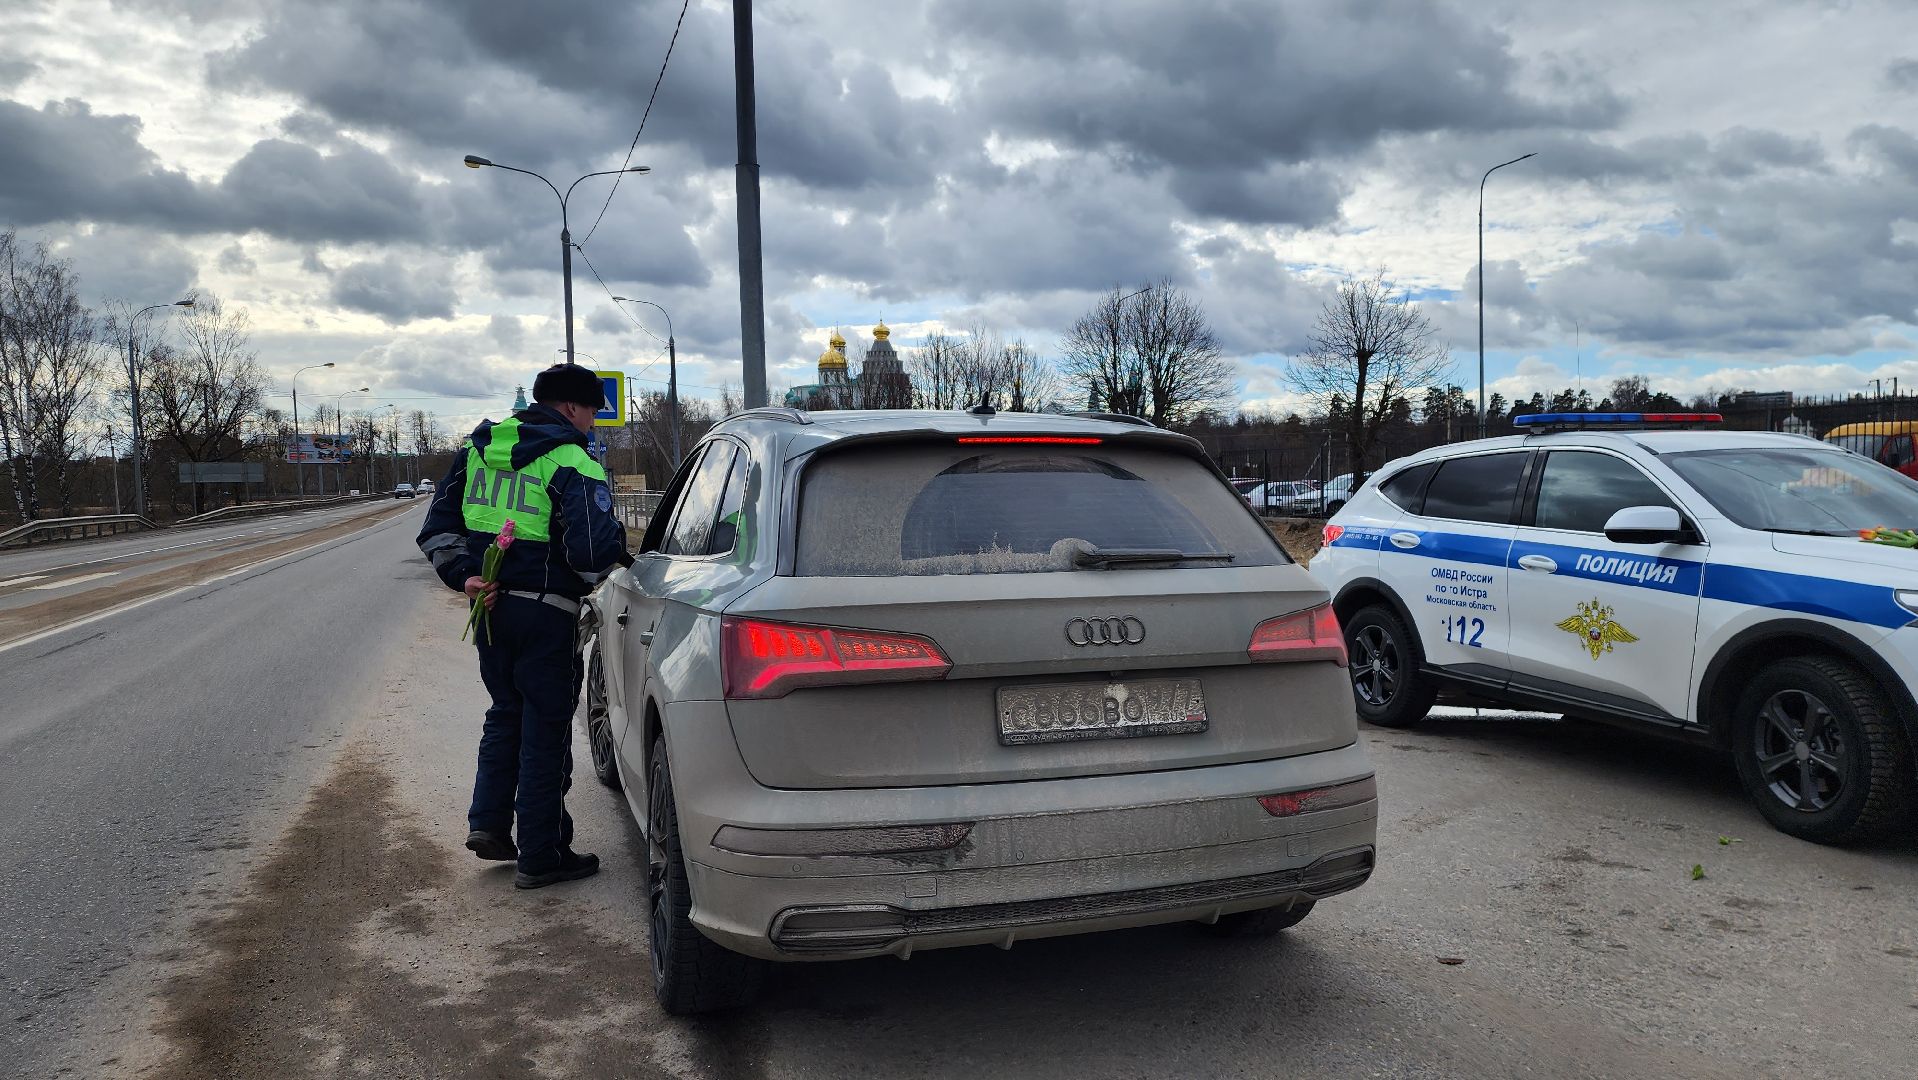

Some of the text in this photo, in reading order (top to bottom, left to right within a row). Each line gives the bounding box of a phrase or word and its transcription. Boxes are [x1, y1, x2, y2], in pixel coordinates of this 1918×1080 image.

[466, 467, 542, 515] ДПС
[1431, 567, 1494, 584] ОМВД России
[1575, 553, 1679, 584] ПОЛИЦИЯ
[1435, 584, 1447, 593] по
[1460, 585, 1488, 600] Истра
[1426, 594, 1497, 612] Московская область
